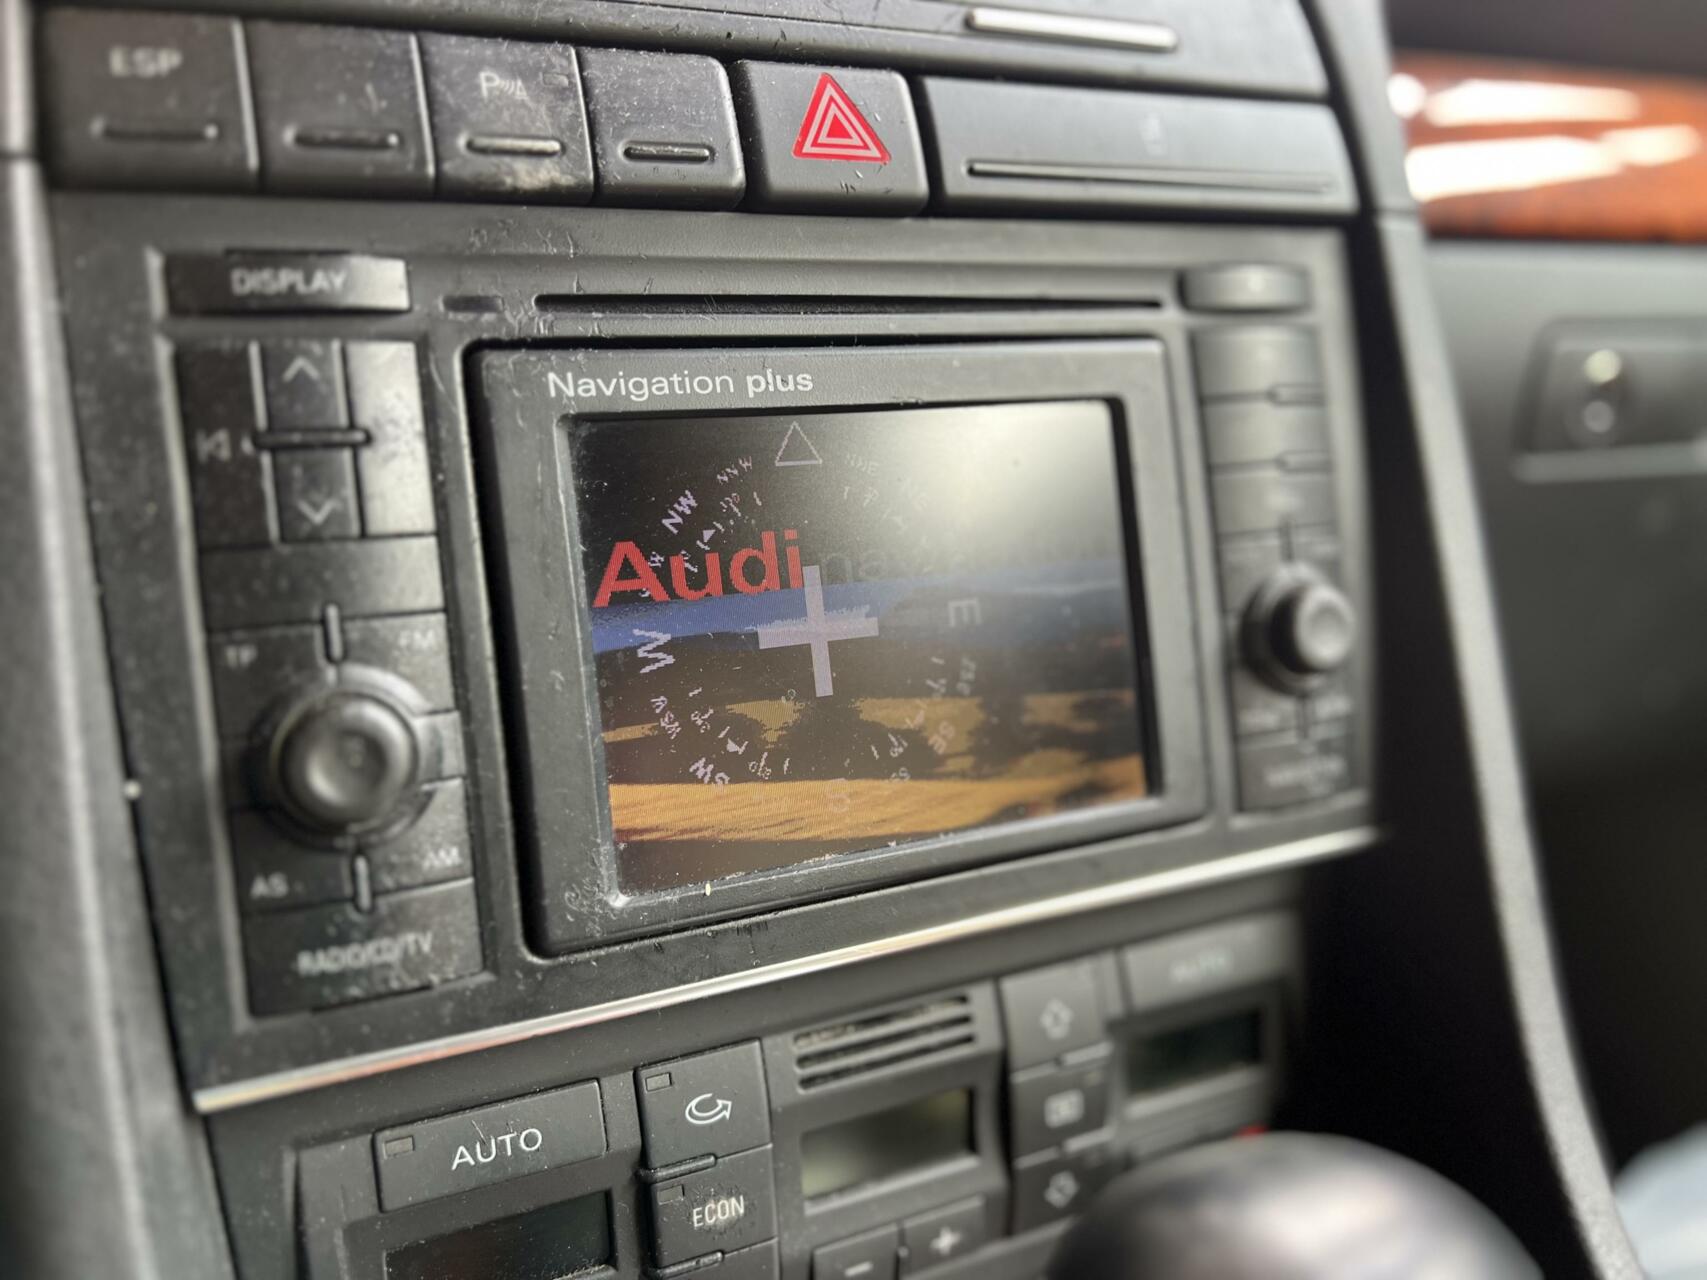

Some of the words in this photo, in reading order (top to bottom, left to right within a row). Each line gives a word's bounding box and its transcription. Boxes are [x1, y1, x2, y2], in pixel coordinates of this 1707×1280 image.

[108, 46, 183, 77] ESP
[231, 266, 348, 295] DISPLAY
[546, 370, 735, 402] Navigation
[746, 368, 815, 398] plus
[661, 489, 698, 535] NW
[592, 528, 804, 608] Audi
[401, 629, 436, 652] FM
[632, 628, 676, 674] W
[423, 846, 460, 870] AM
[251, 873, 290, 899] AS
[451, 1128, 543, 1171] AUTO
[692, 1195, 746, 1229] ECON
